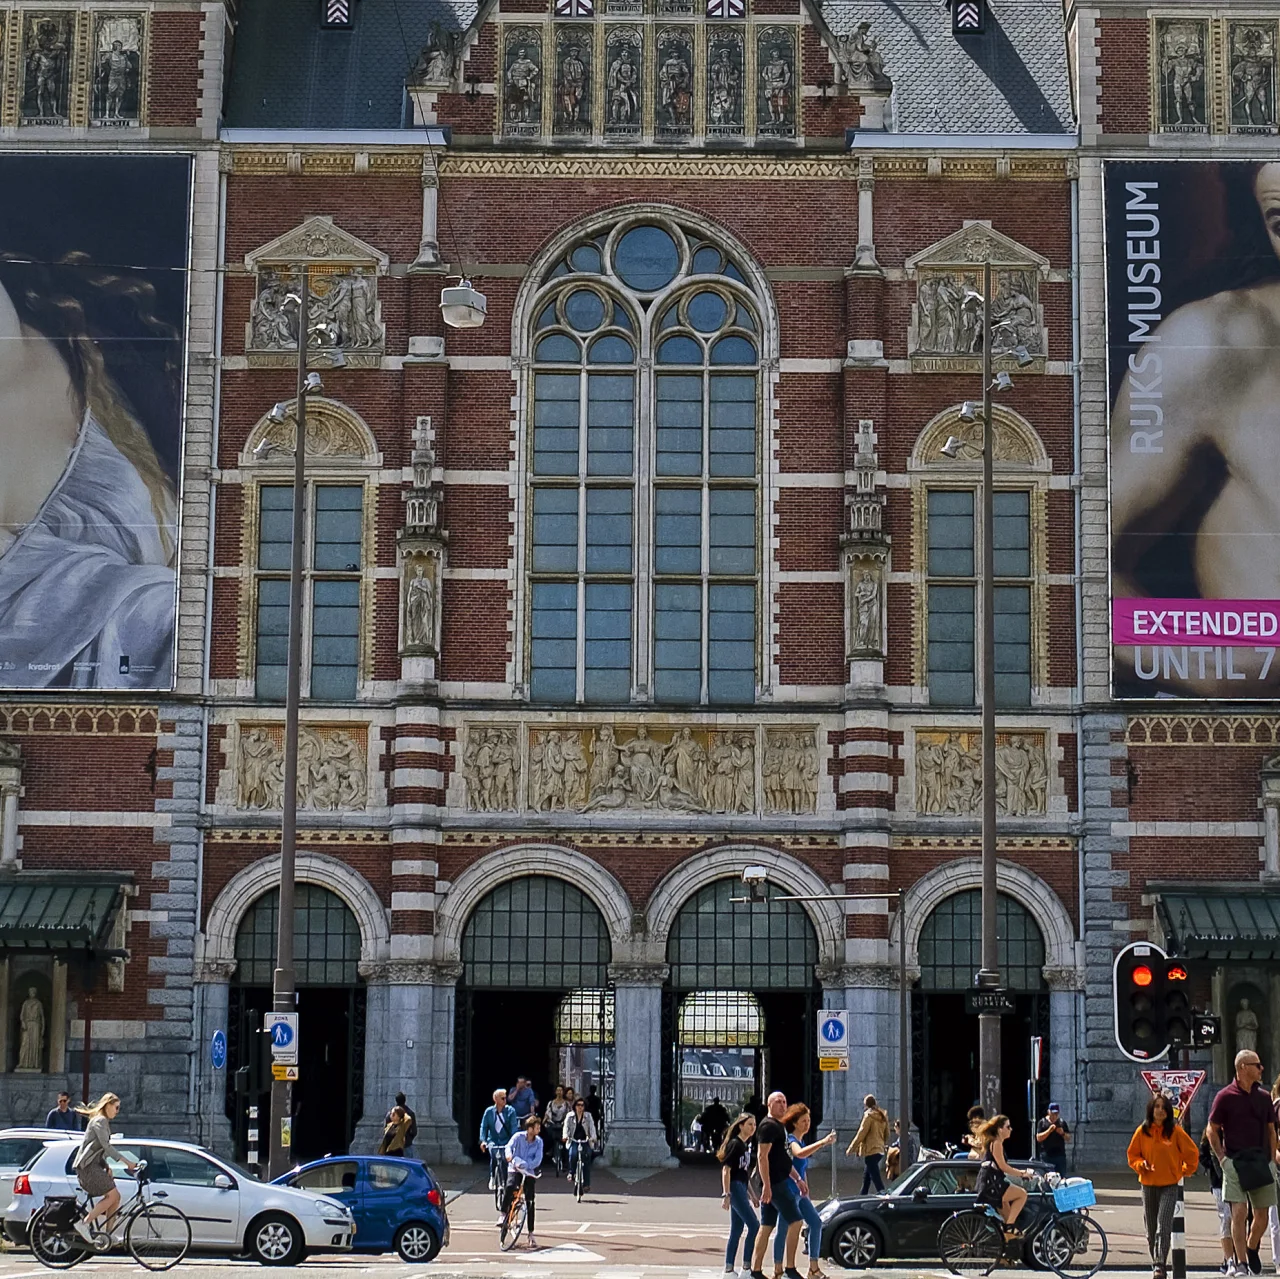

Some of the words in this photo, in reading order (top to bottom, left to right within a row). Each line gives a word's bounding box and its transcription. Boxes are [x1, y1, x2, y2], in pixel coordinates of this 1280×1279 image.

[1125, 181, 1162, 345] MUSEUM
[1133, 610, 1278, 637] EXTENDED
[1135, 646, 1248, 681] UNTIL
[1255, 647, 1278, 680] 7
